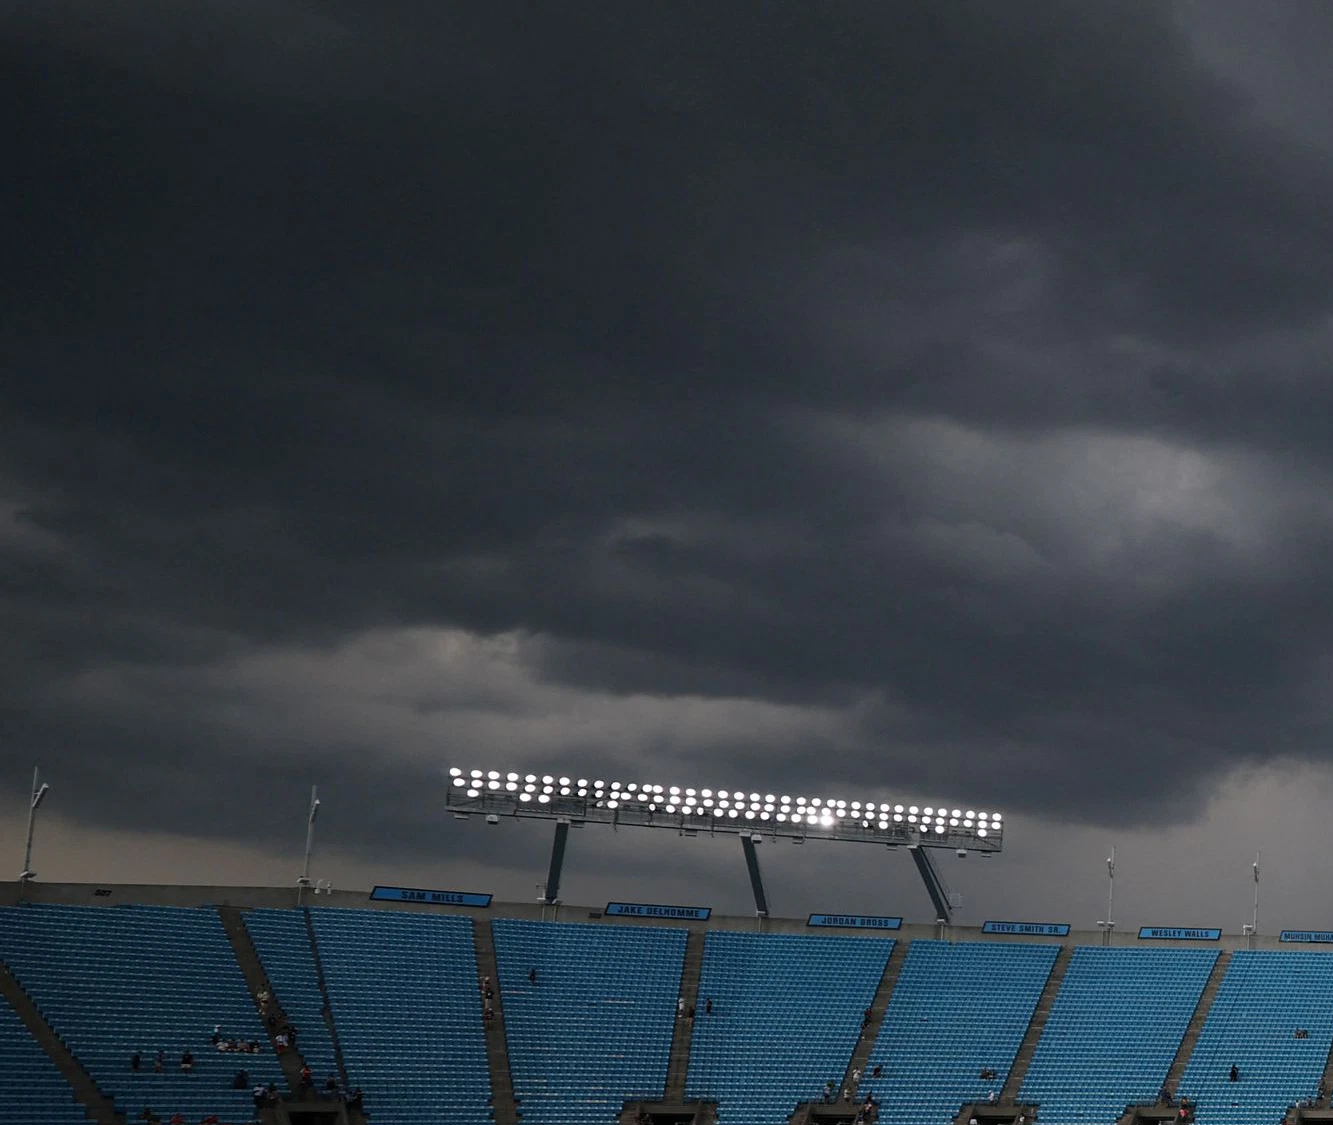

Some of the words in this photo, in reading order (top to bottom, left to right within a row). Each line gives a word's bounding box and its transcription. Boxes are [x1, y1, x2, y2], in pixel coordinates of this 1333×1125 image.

[431, 893, 465, 903] MILLS
[617, 905, 643, 914] JAKE
[1019, 925, 1044, 934] SMITH
[1151, 928, 1182, 938] WESLEY
[1184, 929, 1210, 939] WALLS
